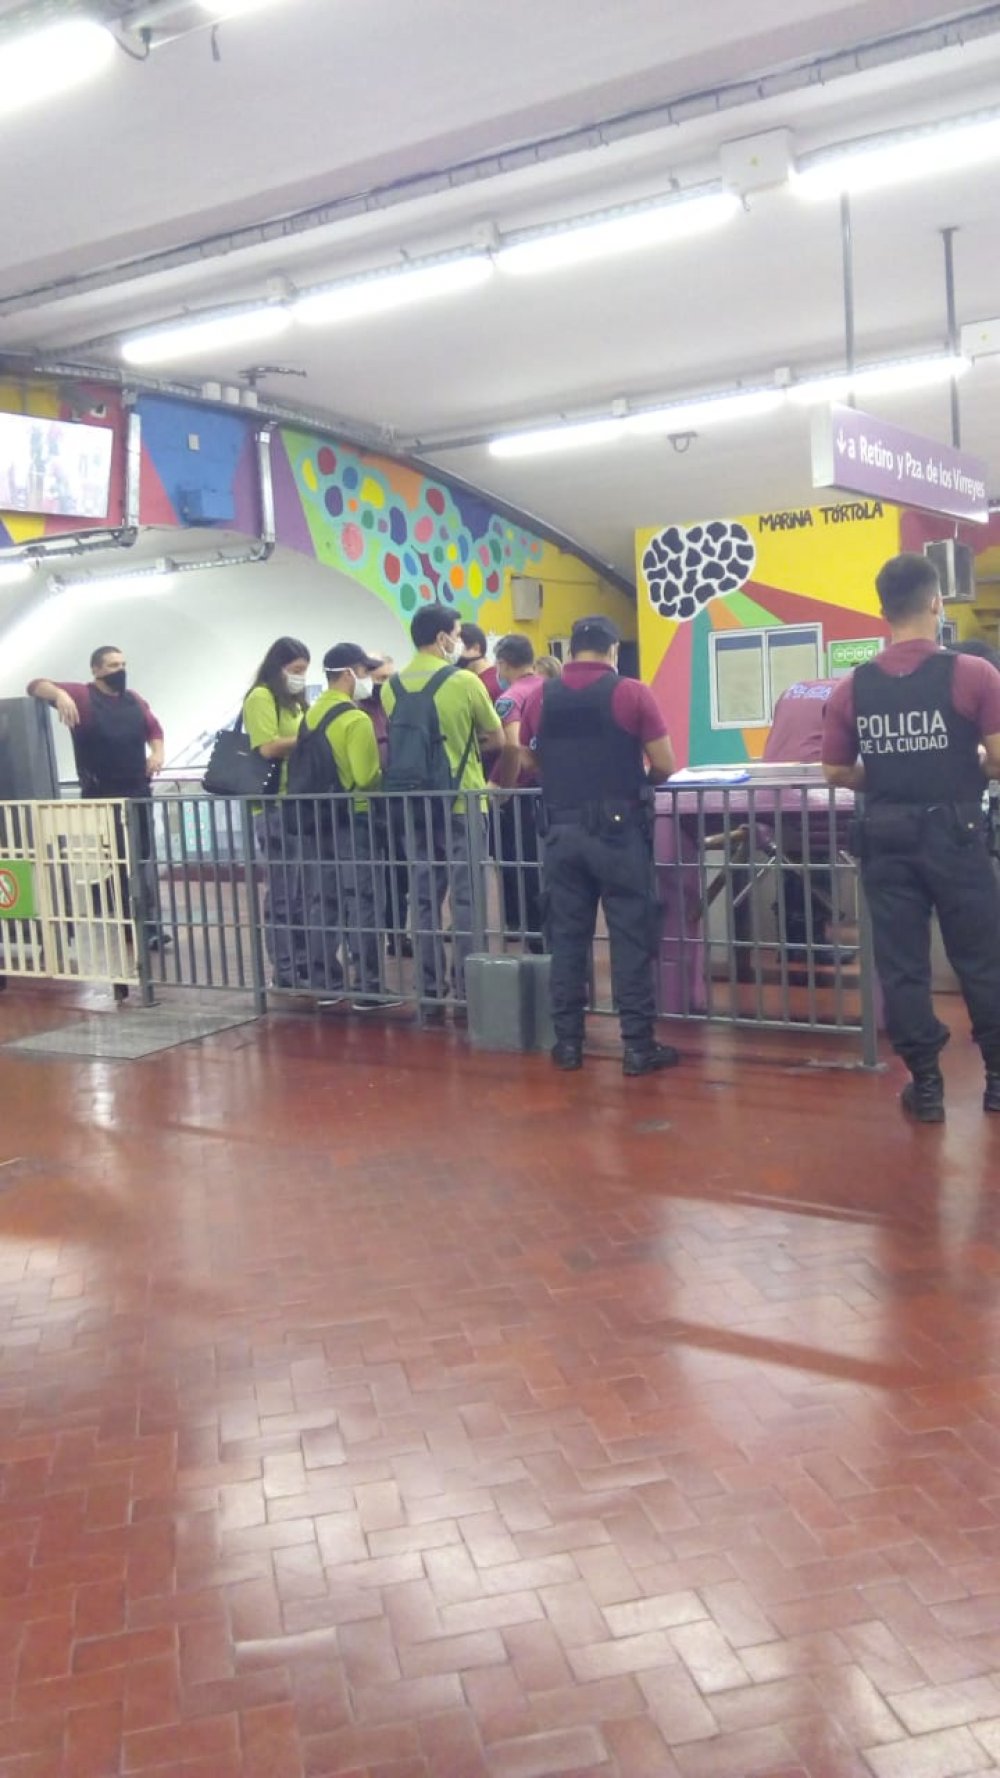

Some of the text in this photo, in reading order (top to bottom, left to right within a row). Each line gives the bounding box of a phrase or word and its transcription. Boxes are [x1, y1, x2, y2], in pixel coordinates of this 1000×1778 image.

[849, 436, 986, 502] a Retiro y Pza. de los Virreyes
[857, 710, 947, 739] POLICIA
[860, 734, 948, 754] DE LA CIUDAD
